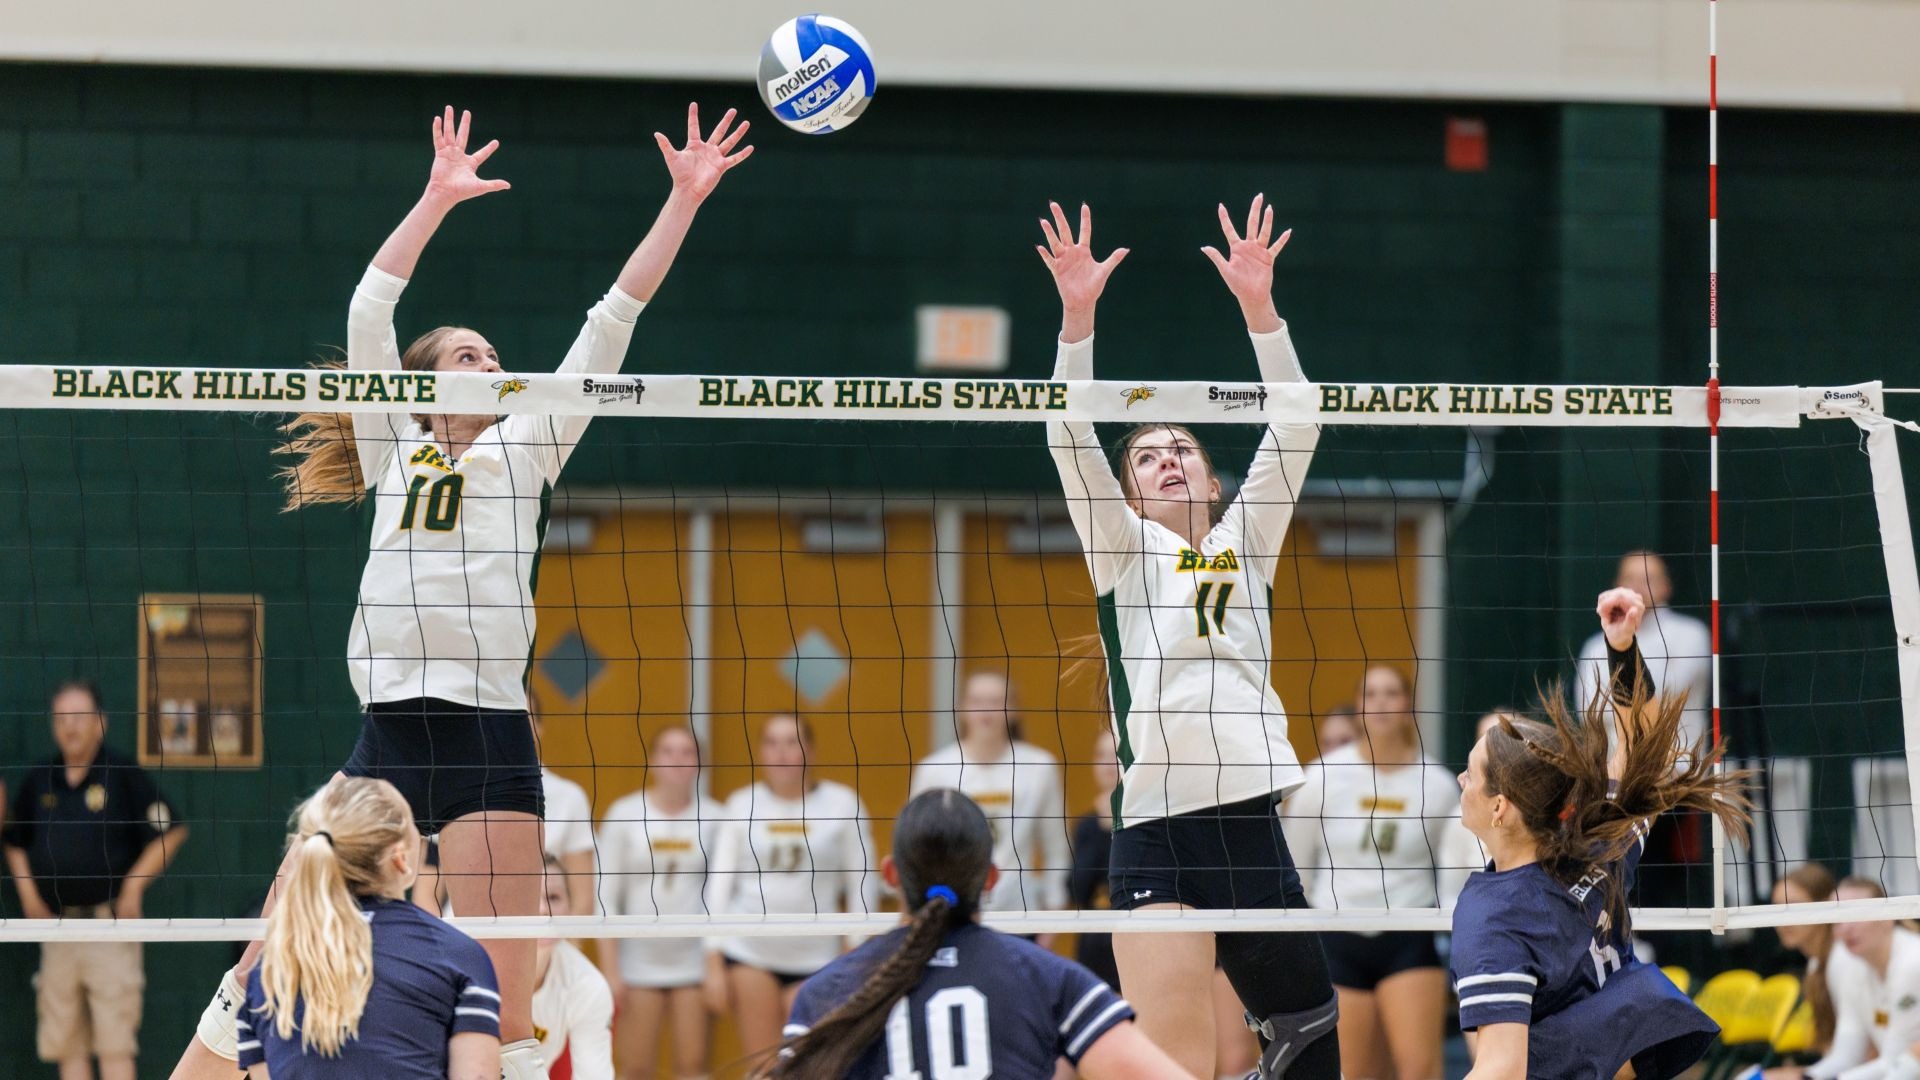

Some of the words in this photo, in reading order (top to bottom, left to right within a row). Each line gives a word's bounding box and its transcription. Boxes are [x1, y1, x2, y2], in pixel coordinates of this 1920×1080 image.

[775, 57, 832, 100] molten
[791, 78, 841, 117] NCAA
[53, 369, 182, 399] BLACK
[193, 371, 306, 401] HILLS
[318, 373, 436, 402] STATE
[699, 378, 823, 407] BLACK
[834, 379, 943, 409] HILLS
[953, 382, 1068, 410] STATE
[1319, 385, 1439, 412] BLACK
[1449, 386, 1553, 414] HILLS
[1564, 388, 1673, 415] STATE
[1833, 390, 1862, 400] Senoh
[400, 473, 464, 532] 10
[1196, 581, 1234, 637] 11
[883, 986, 992, 1080] 10
